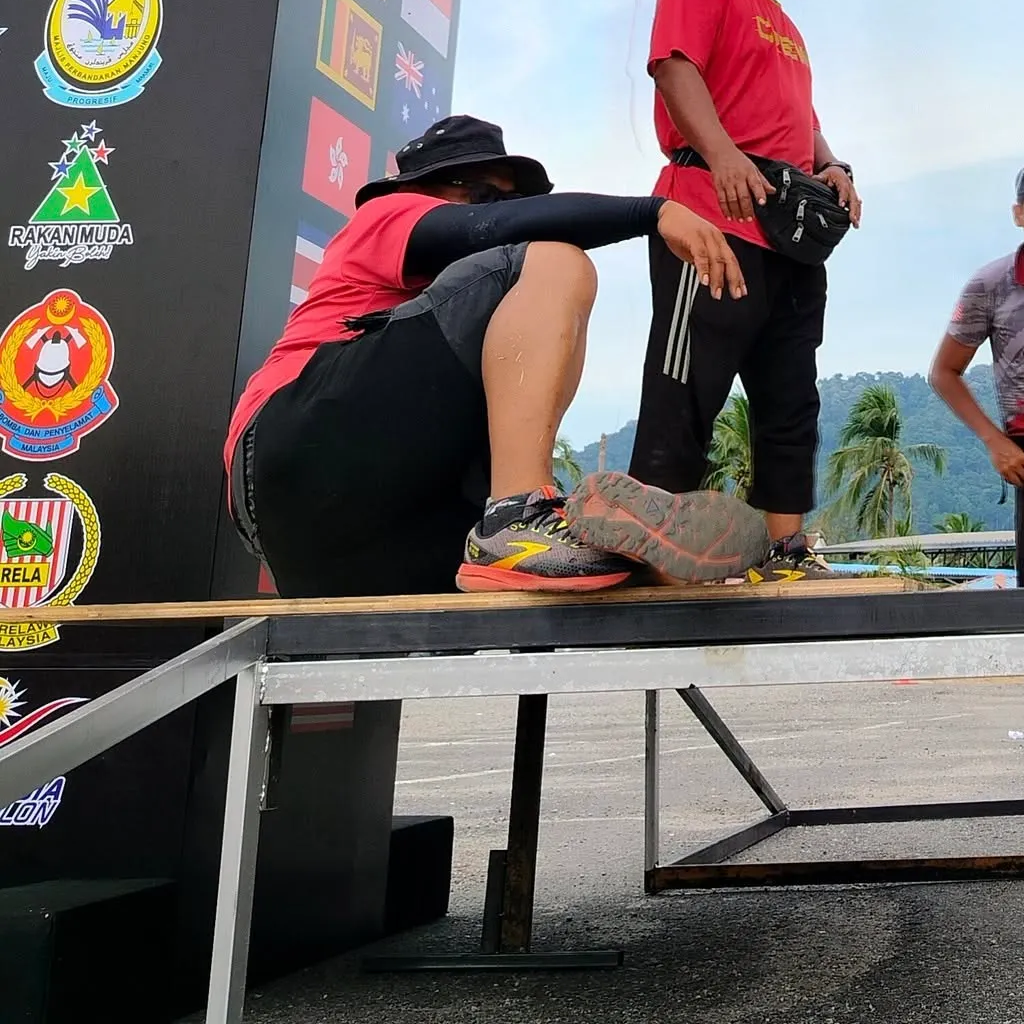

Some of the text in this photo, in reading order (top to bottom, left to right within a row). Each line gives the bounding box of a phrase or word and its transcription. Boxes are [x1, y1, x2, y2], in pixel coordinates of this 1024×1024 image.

[8, 224, 134, 246] RAKAN MUDA
[24, 428, 40, 436] DAN
[44, 413, 94, 436] PENYELAMAT
[21, 444, 60, 453] MALAYSIA
[1, 567, 41, 583] RELA
